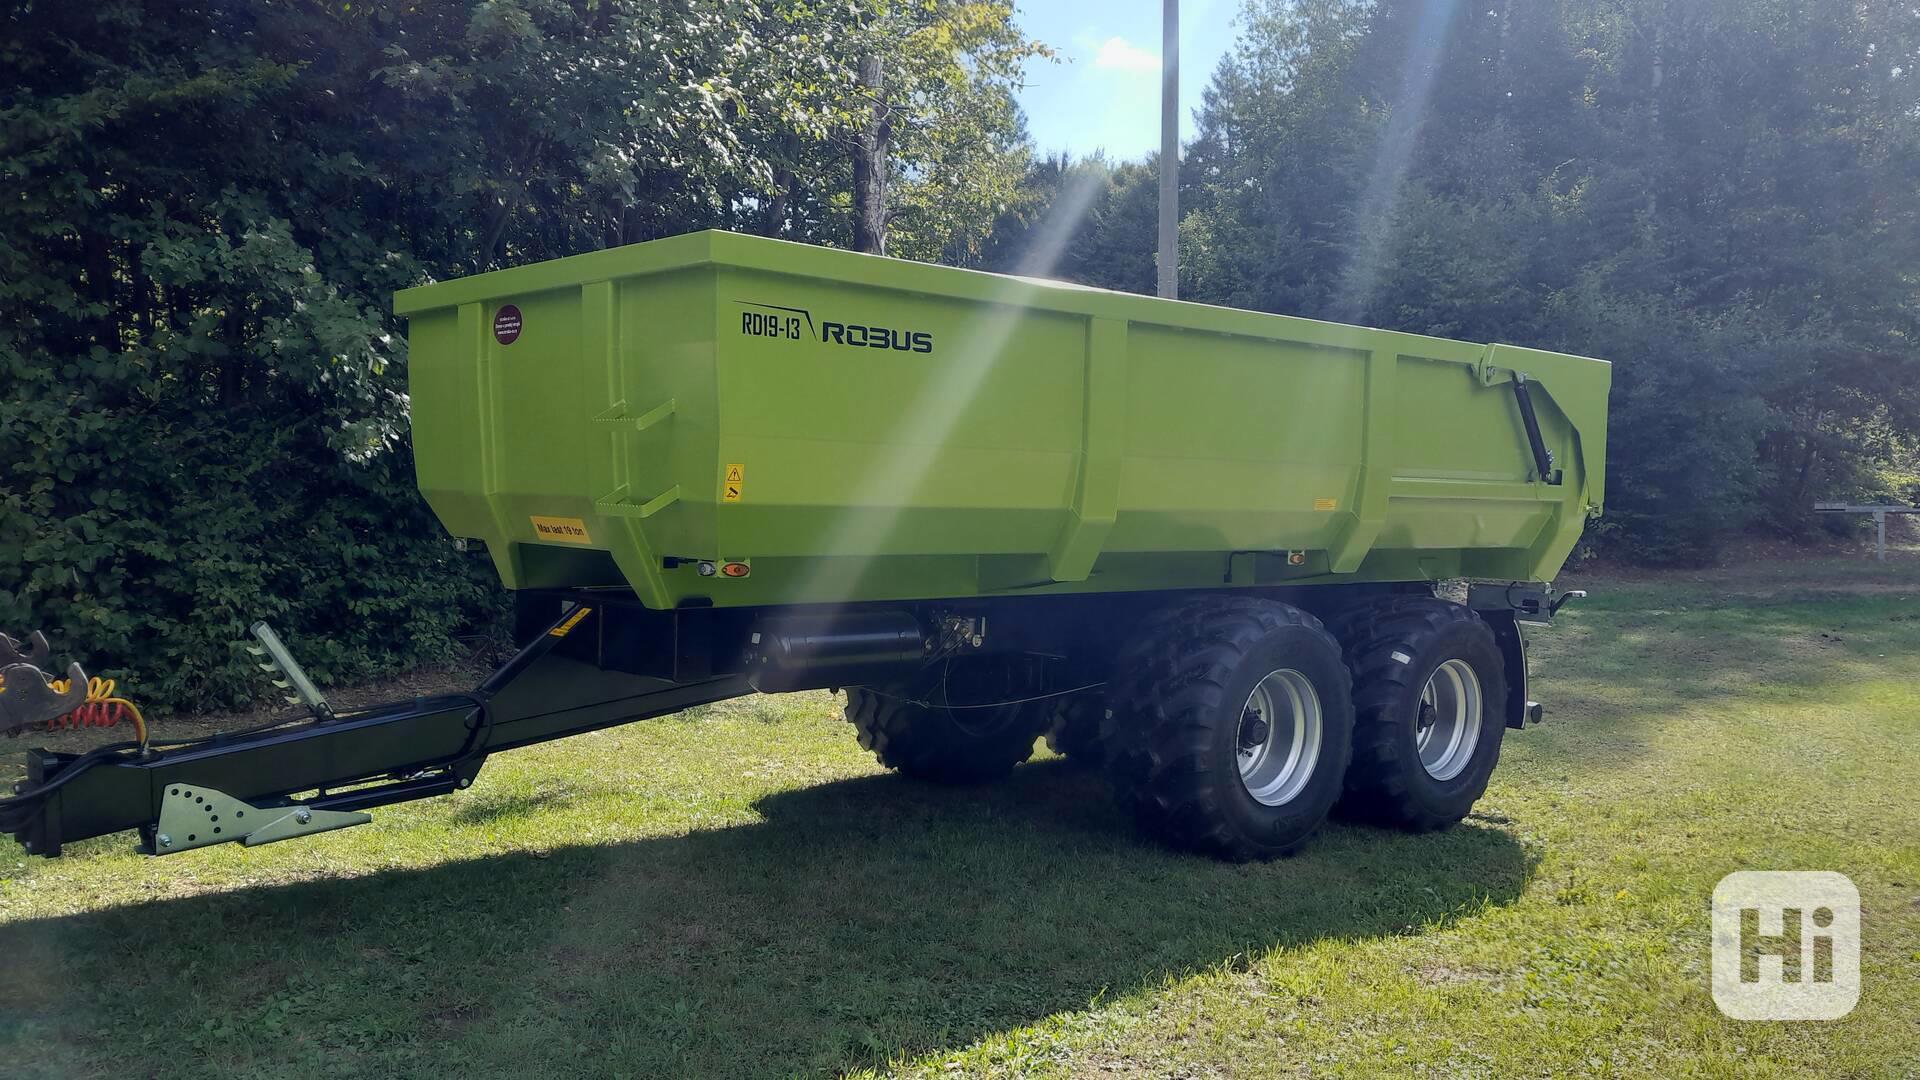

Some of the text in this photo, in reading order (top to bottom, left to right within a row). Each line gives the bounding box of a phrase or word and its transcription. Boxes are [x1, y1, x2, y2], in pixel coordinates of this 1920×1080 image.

[742, 311, 933, 354] RD19-13 ROBUS
[536, 523, 585, 537] Max last 19 ton
